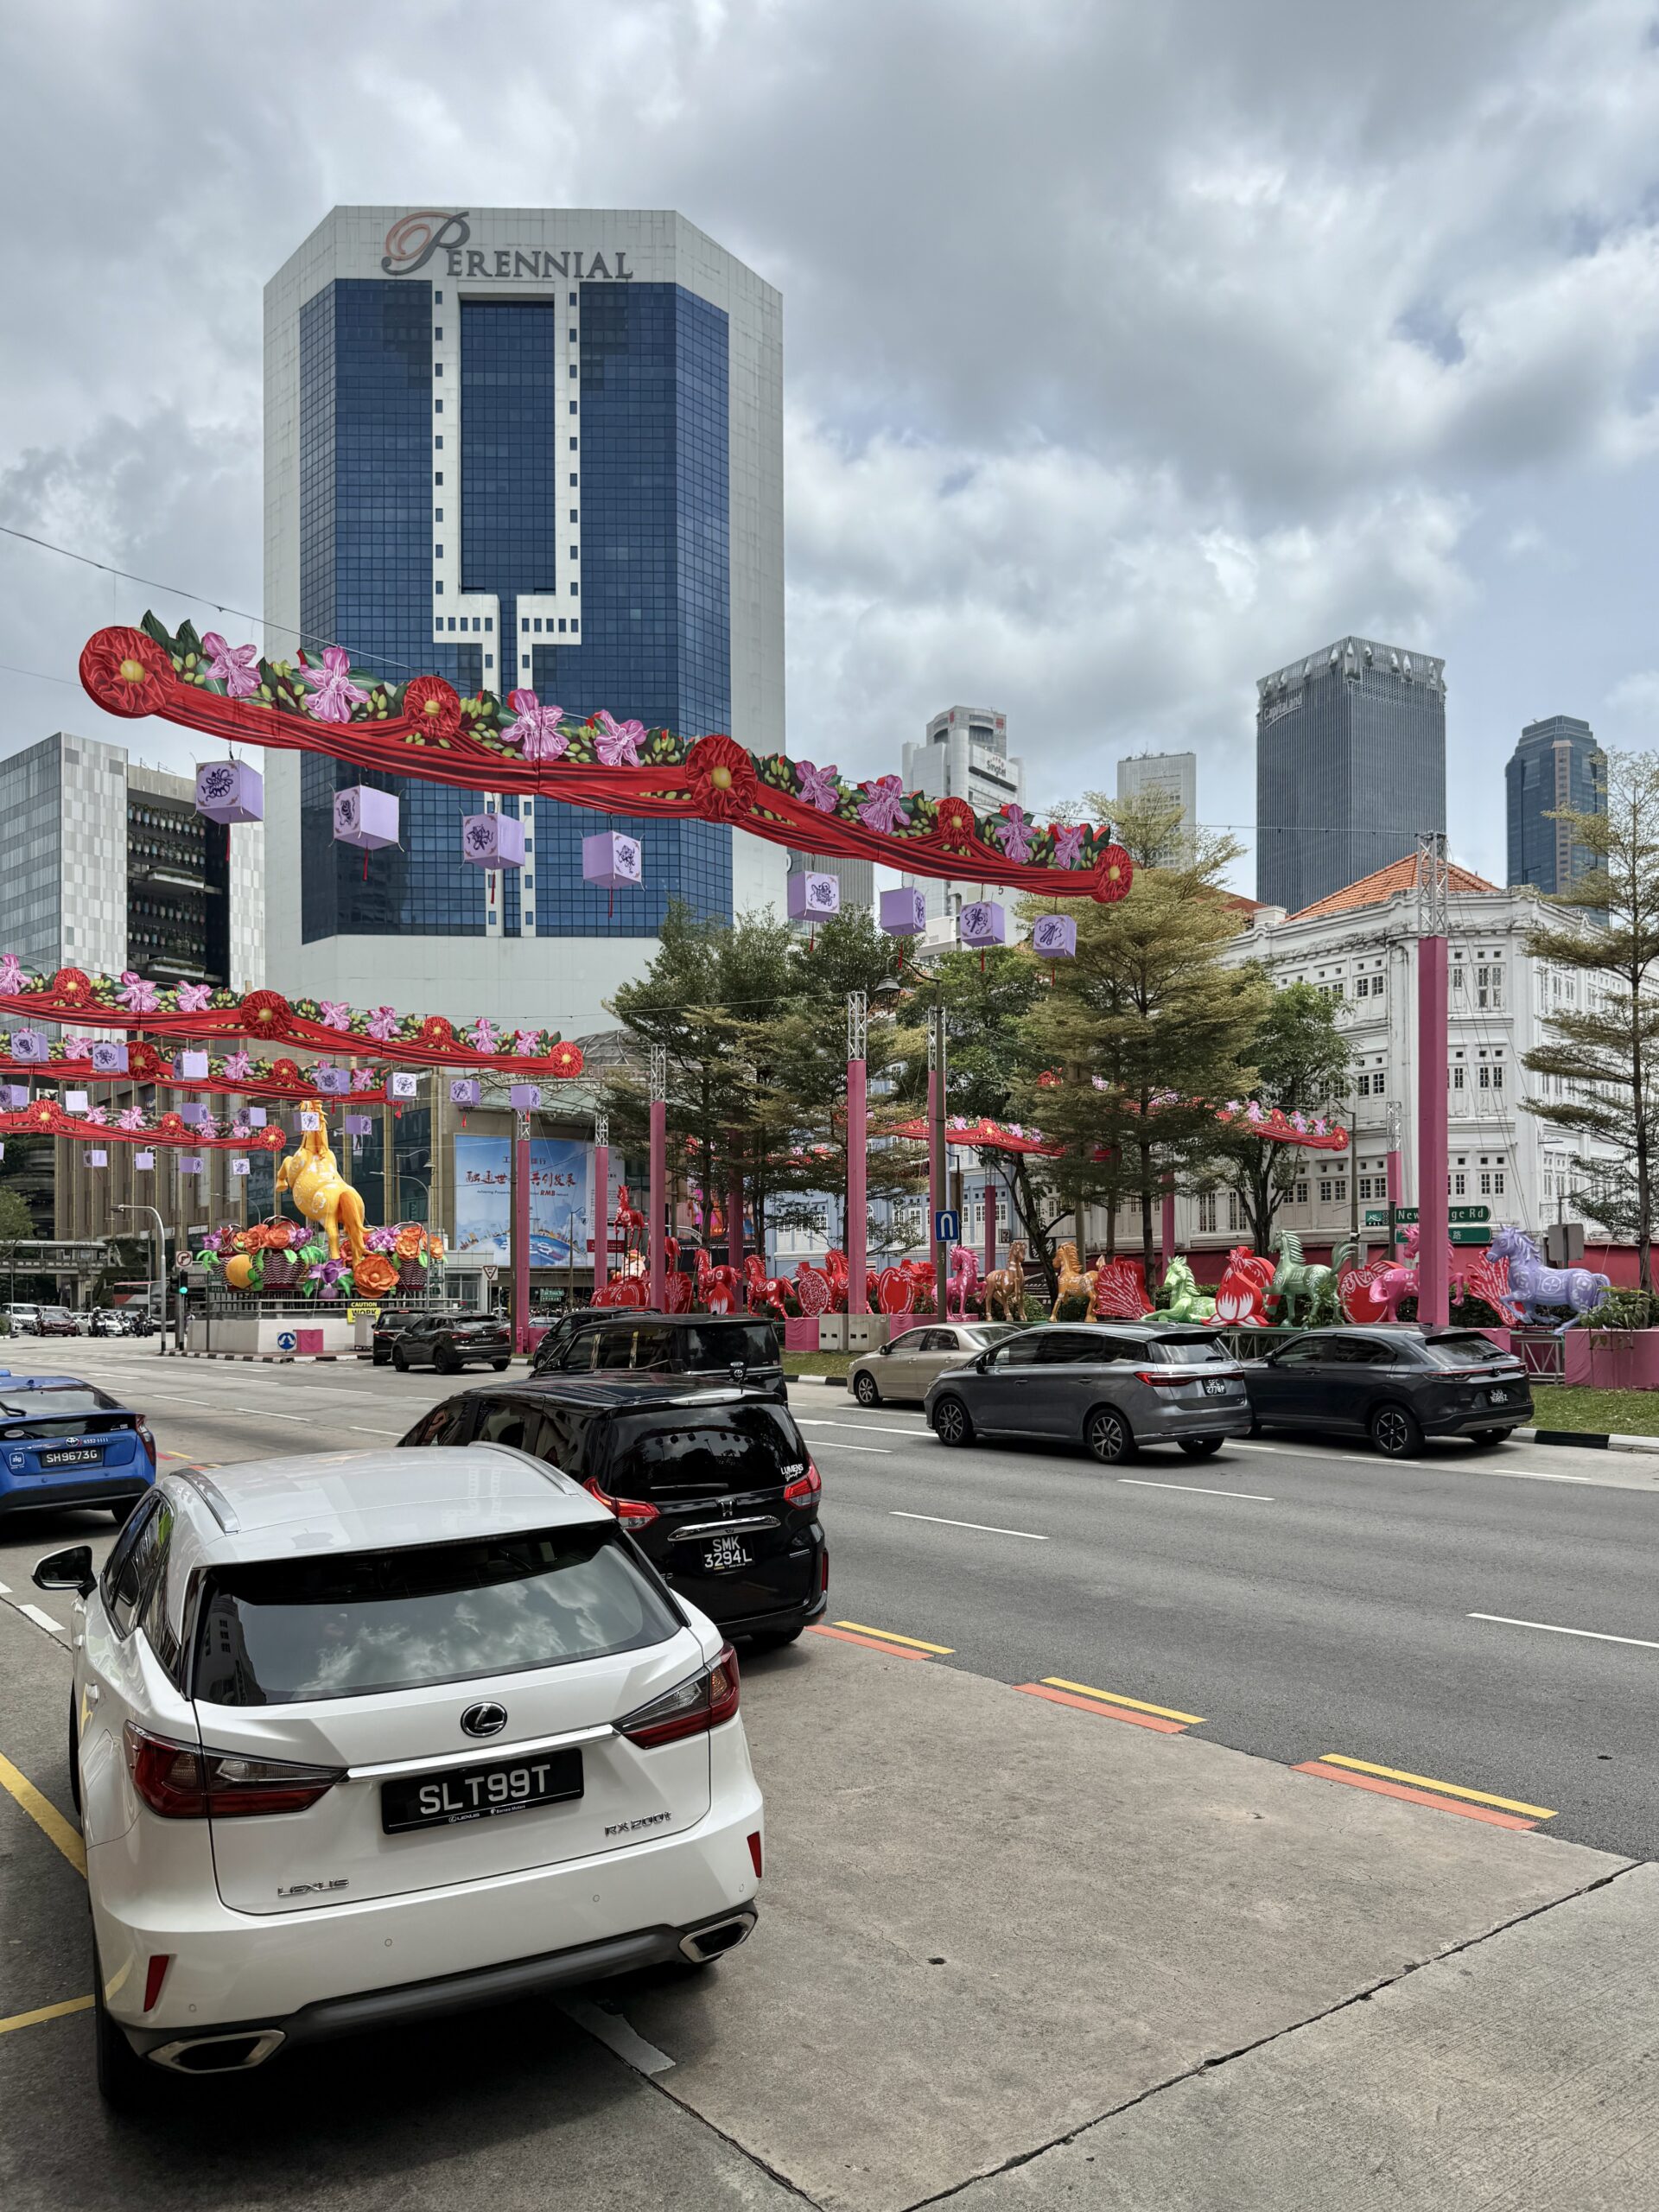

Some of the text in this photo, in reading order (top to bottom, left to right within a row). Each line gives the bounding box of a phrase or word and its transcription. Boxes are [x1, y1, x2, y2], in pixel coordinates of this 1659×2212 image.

[380, 211, 633, 278] PERENNIAL
[1263, 690, 1303, 721] CapitaLand
[986, 760, 1007, 778] Singtel
[1469, 1208, 1484, 1218] Rd
[46, 1450, 99, 1463] SH9673G
[780, 1463, 804, 1475] LUMENS
[712, 1535, 741, 1552] SMK
[704, 1548, 753, 1568] 3294L
[419, 1764, 551, 1815] SLT99T
[457, 1812, 480, 1821] LEXUS
[277, 1878, 350, 1897] LEXUS
